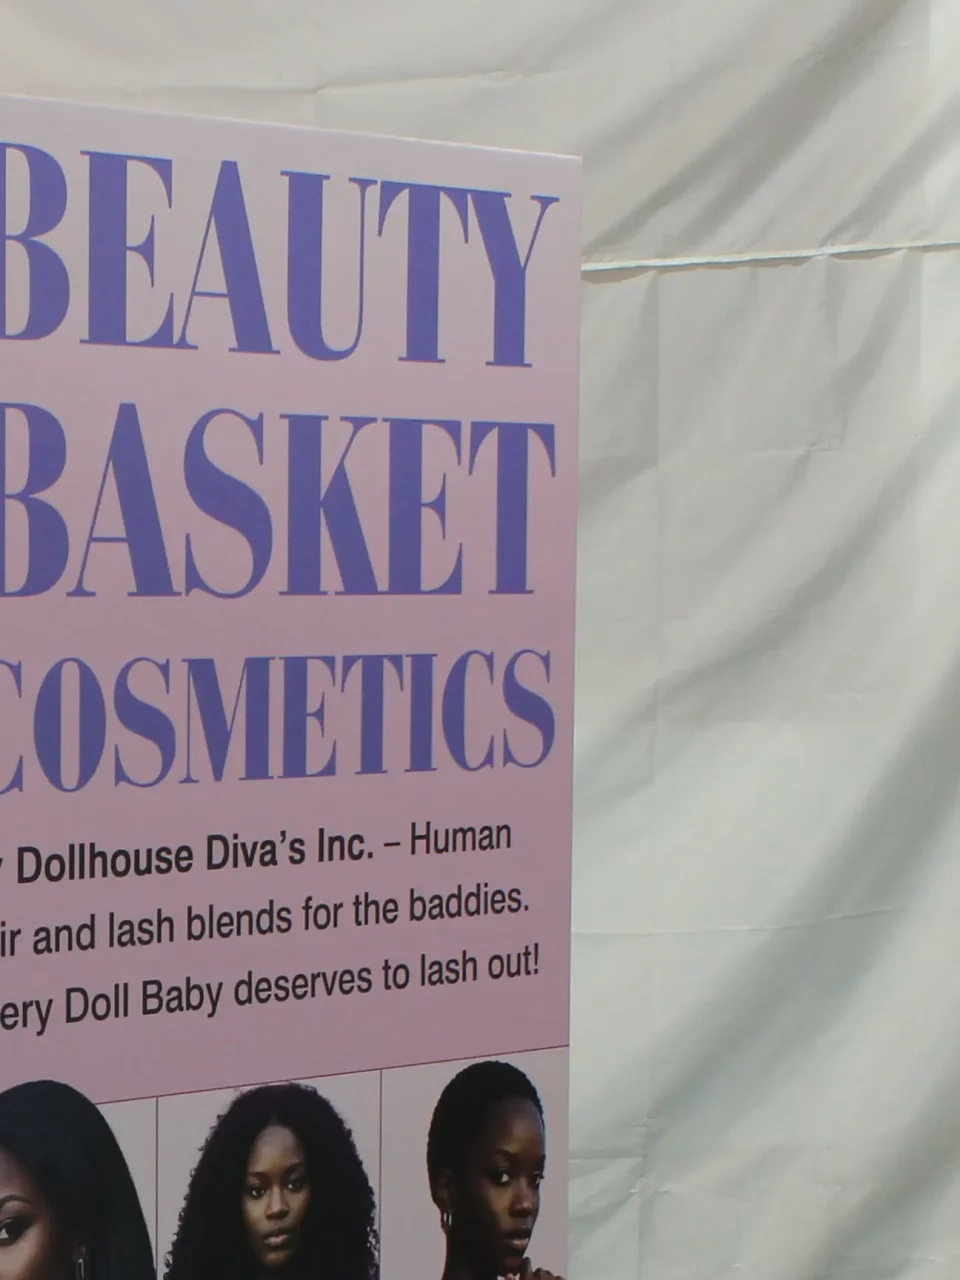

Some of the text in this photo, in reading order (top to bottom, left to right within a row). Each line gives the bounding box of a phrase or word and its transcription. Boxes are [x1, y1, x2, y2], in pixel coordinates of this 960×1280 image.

[18, 841, 193, 884] Dollhouse
[207, 830, 305, 870] Diva’s
[318, 828, 374, 862] Inc.
[411, 821, 512, 855] Human
[33, 914, 96, 955] and
[109, 908, 174, 947] lash
[187, 899, 292, 941] blends
[302, 896, 343, 930] for
[353, 892, 399, 926] the
[410, 883, 529, 921] baddies.
[66, 983, 129, 1023] Doll
[142, 975, 223, 1018] Baby
[234, 967, 372, 1006] deserves
[382, 959, 410, 990] to
[421, 950, 477, 986] lash
[488, 943, 539, 979] out!
